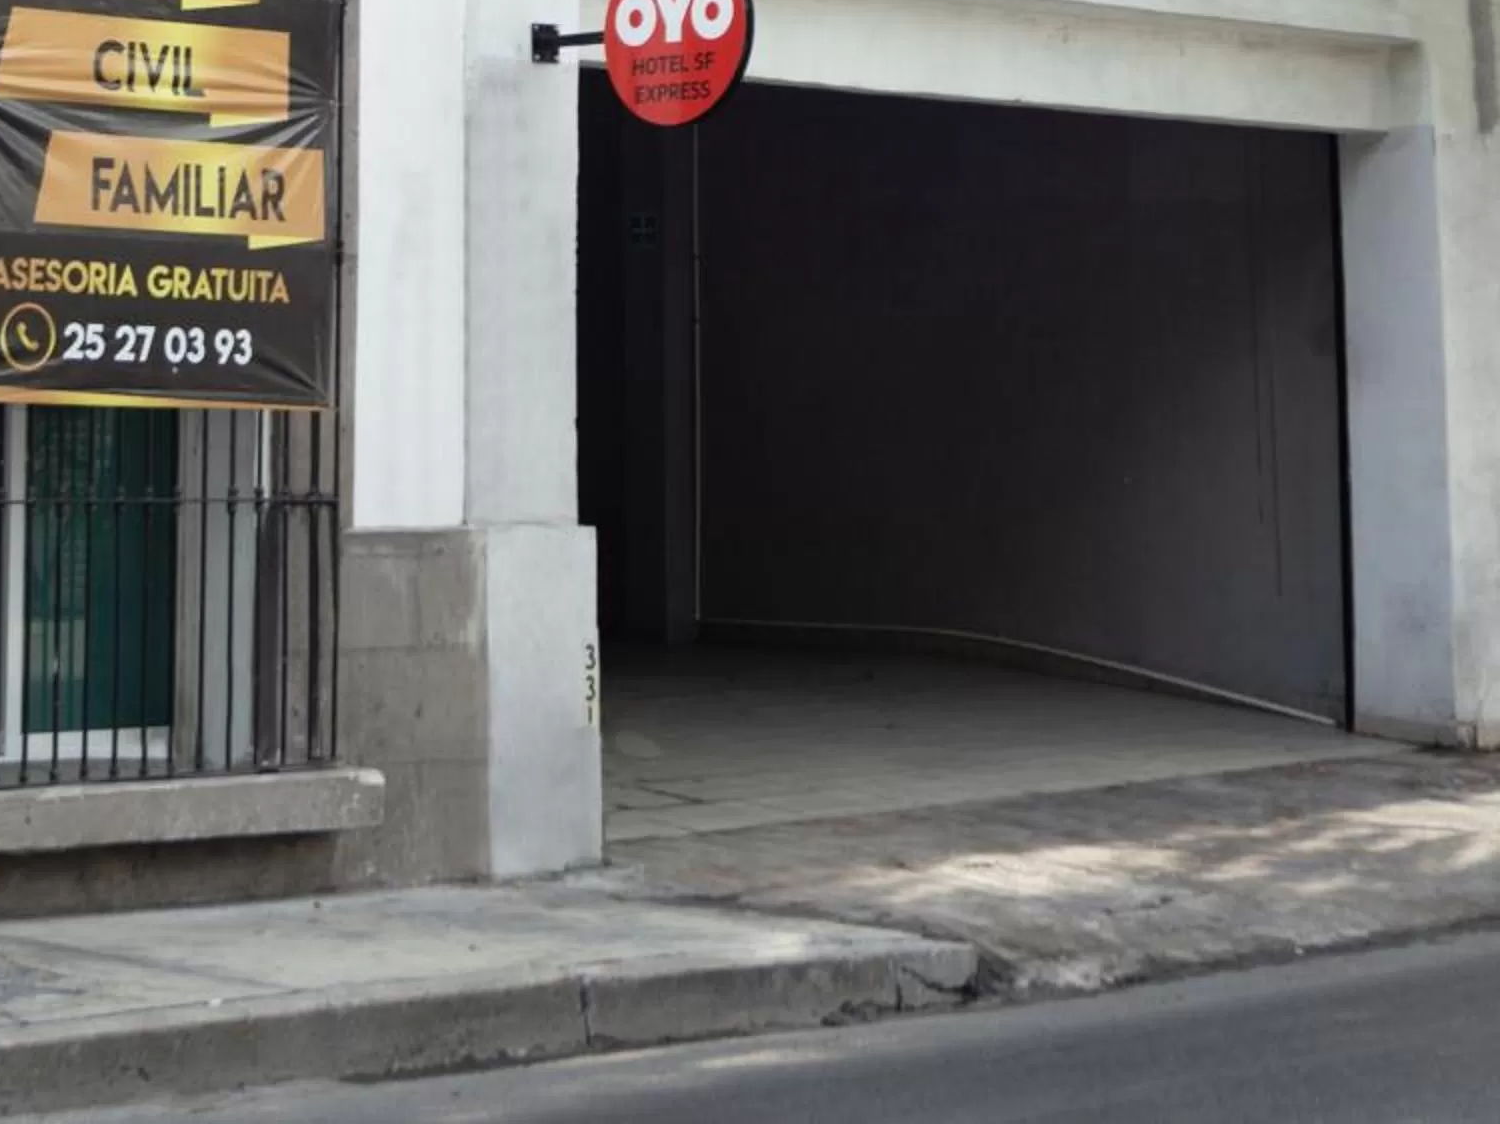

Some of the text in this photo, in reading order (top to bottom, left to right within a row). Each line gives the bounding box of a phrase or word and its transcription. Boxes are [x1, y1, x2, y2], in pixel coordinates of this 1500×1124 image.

[93, 39, 207, 98] CIVIL
[631, 51, 717, 76] HOTEL SF
[635, 80, 711, 104] EXPRESS
[90, 157, 287, 223] FAMILIAR
[147, 264, 291, 304] GRATUITA
[63, 322, 253, 366] 25 27 03 93
